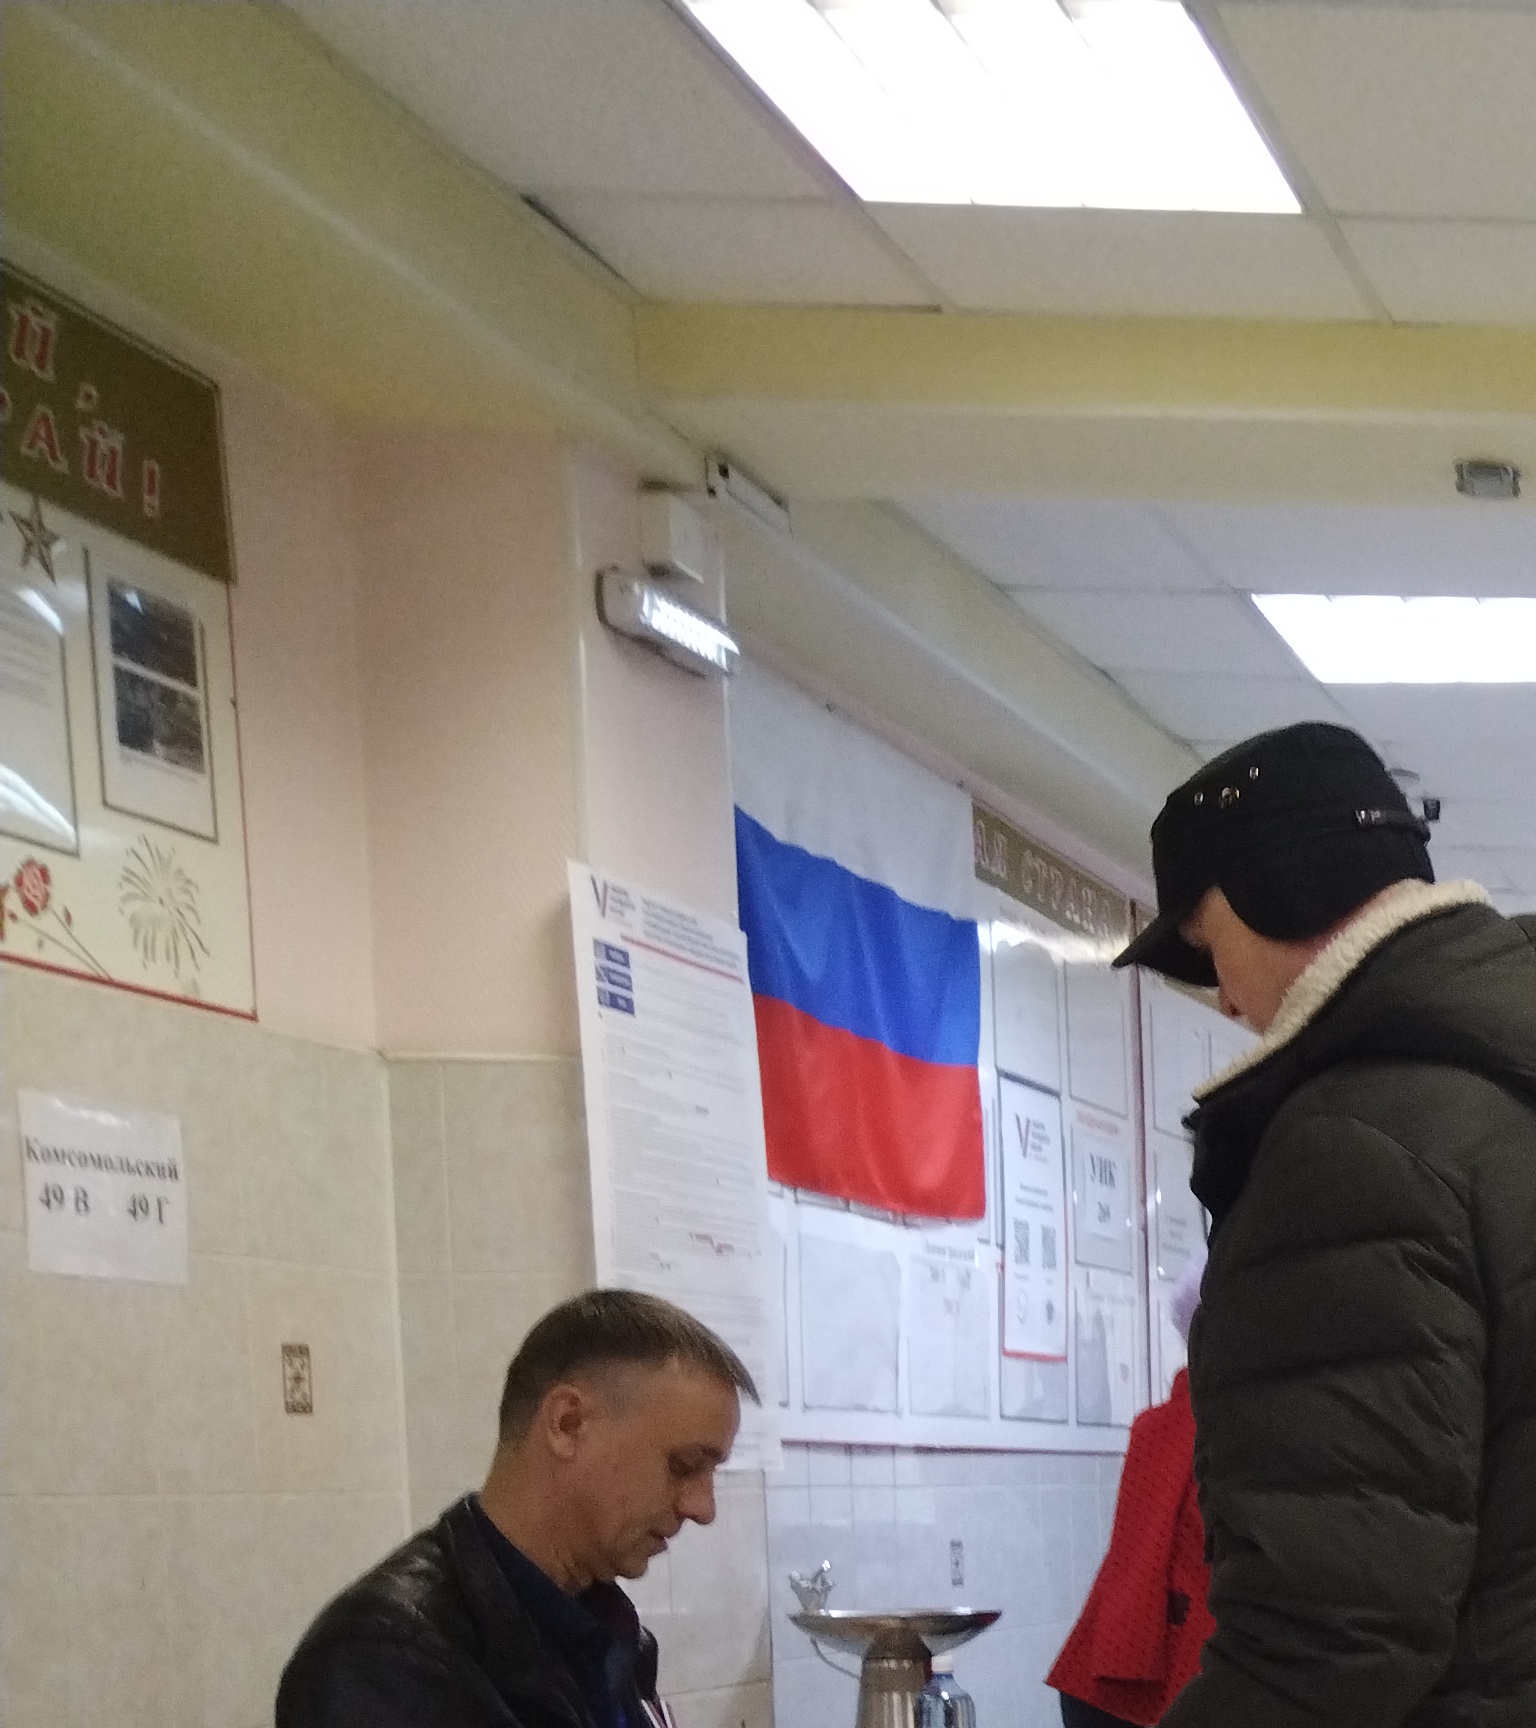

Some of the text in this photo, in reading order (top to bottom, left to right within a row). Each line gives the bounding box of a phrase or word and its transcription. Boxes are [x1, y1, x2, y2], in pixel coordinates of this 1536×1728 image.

[0, 386, 162, 519] АЙ!
[24, 1134, 179, 1182] Комсомольский
[73, 1185, 90, 1215] В
[156, 1196, 170, 1225] Г
